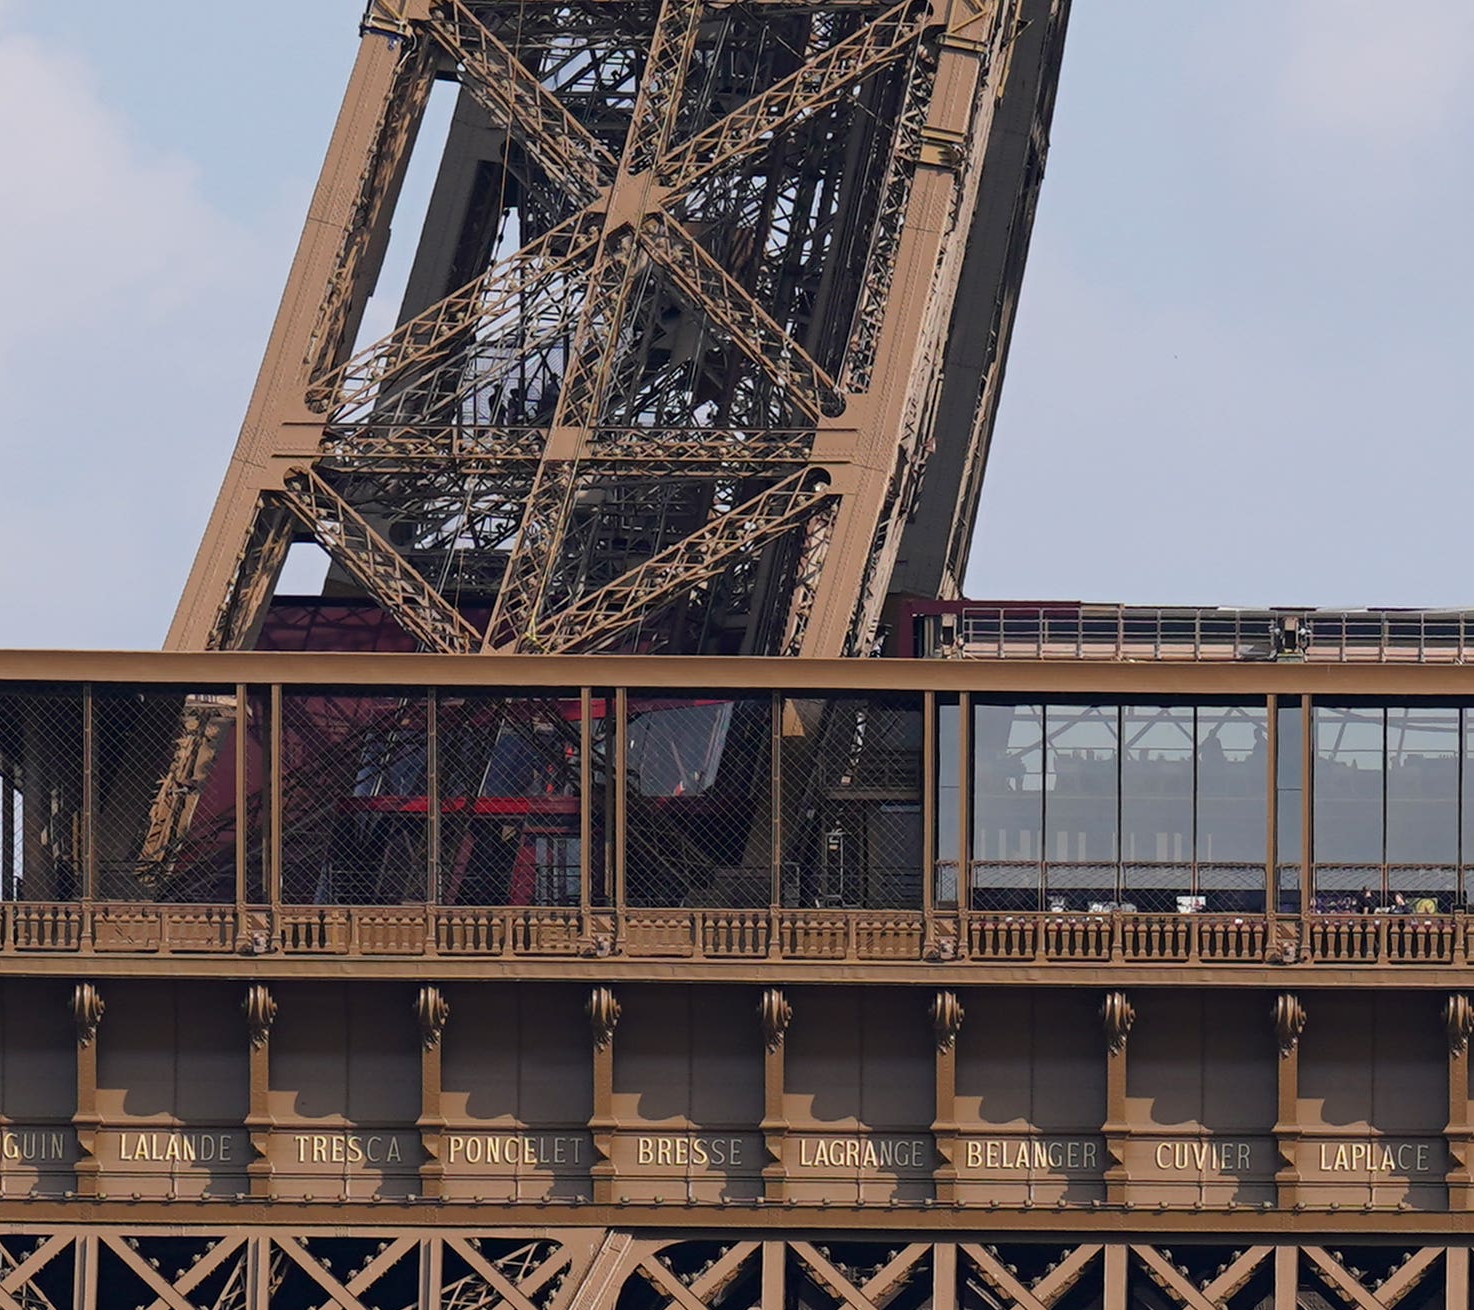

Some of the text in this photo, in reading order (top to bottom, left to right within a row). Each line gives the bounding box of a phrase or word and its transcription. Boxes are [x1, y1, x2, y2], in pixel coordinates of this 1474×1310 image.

[119, 1134, 232, 1162] LALANDE
[294, 1135, 402, 1164] TRESCA
[448, 1135, 583, 1165] PONCELET
[638, 1137, 743, 1166] BRESSE
[799, 1138, 924, 1167] LAGRANGE
[966, 1140, 1097, 1170] BELANGER
[1156, 1141, 1251, 1171] CUVIER
[1319, 1143, 1429, 1172] LAPLACE
